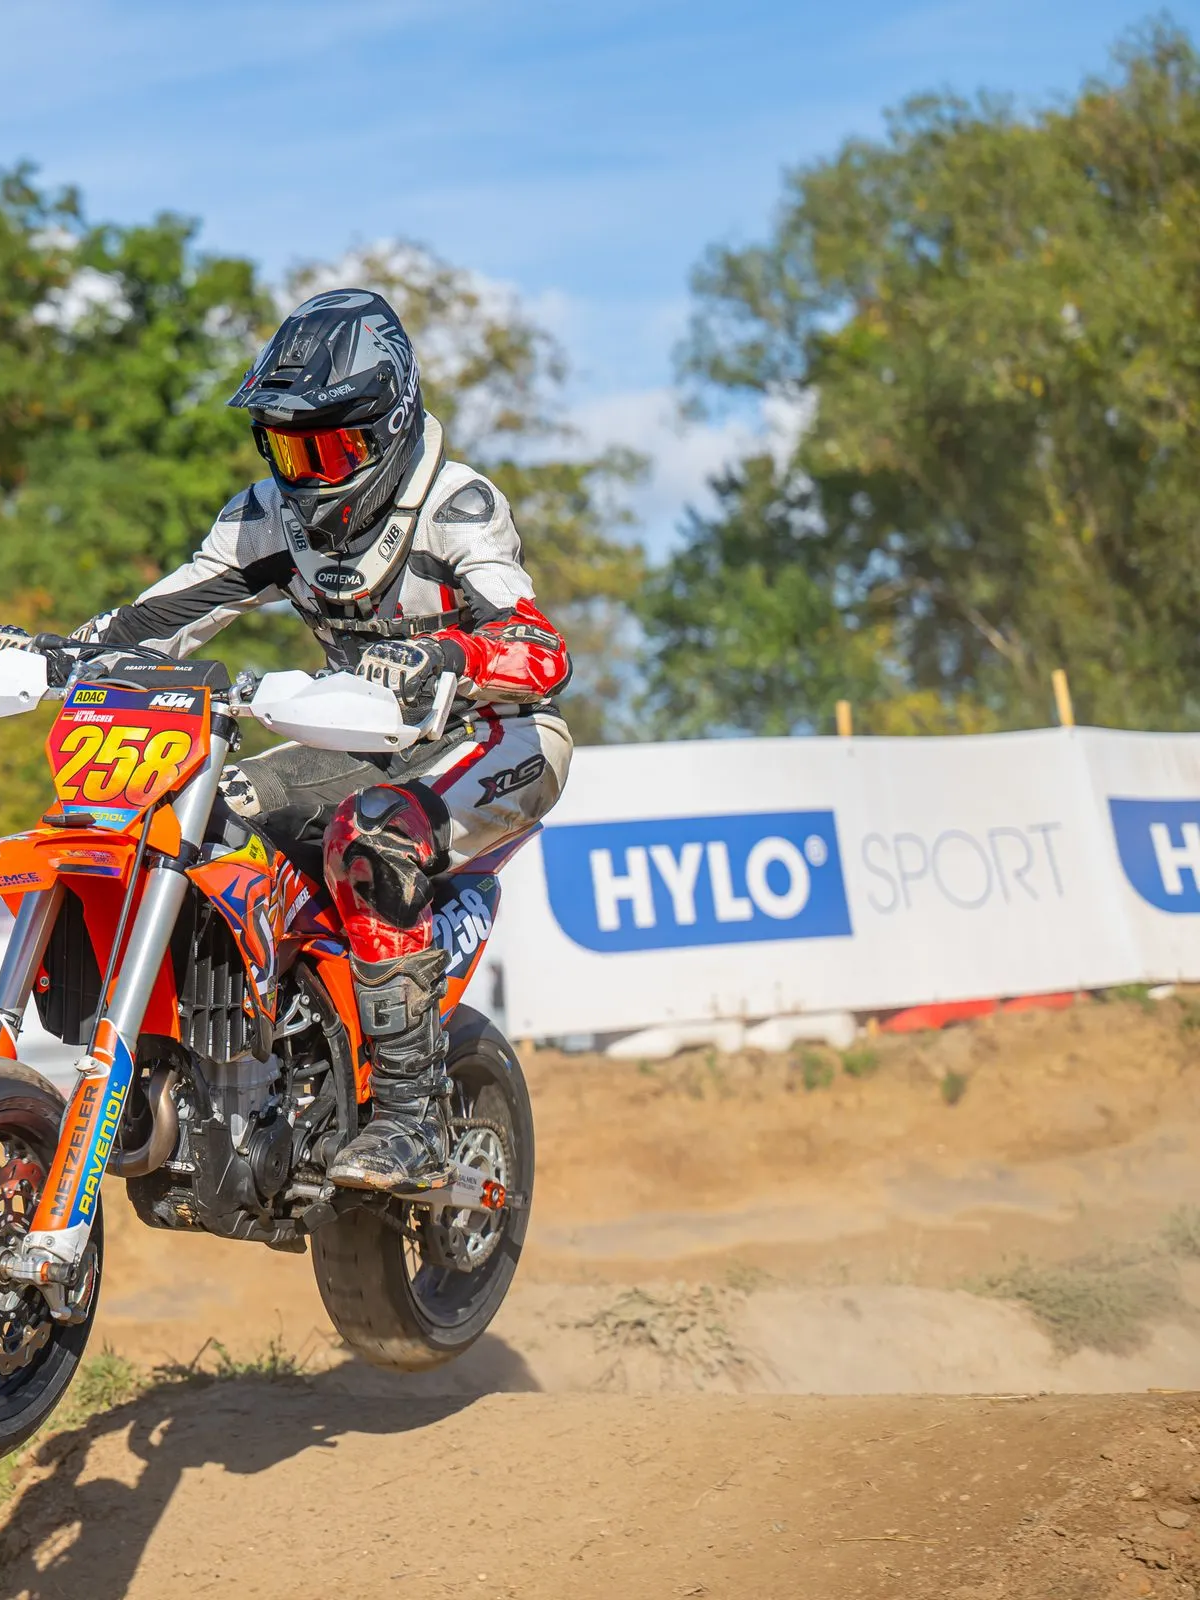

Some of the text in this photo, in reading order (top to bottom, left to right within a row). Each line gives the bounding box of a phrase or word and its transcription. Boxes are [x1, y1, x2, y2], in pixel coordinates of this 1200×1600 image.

[318, 572, 361, 585] ORTEMA
[75, 691, 105, 702] ADAC
[149, 692, 196, 709] KTM
[53, 724, 193, 807] 258
[3, 872, 39, 883] MCE
[589, 821, 1062, 932] HYLO SPORT
[433, 888, 493, 975] 258
[50, 1084, 99, 1217] METZELER
[78, 1083, 127, 1216] RAVENOL
